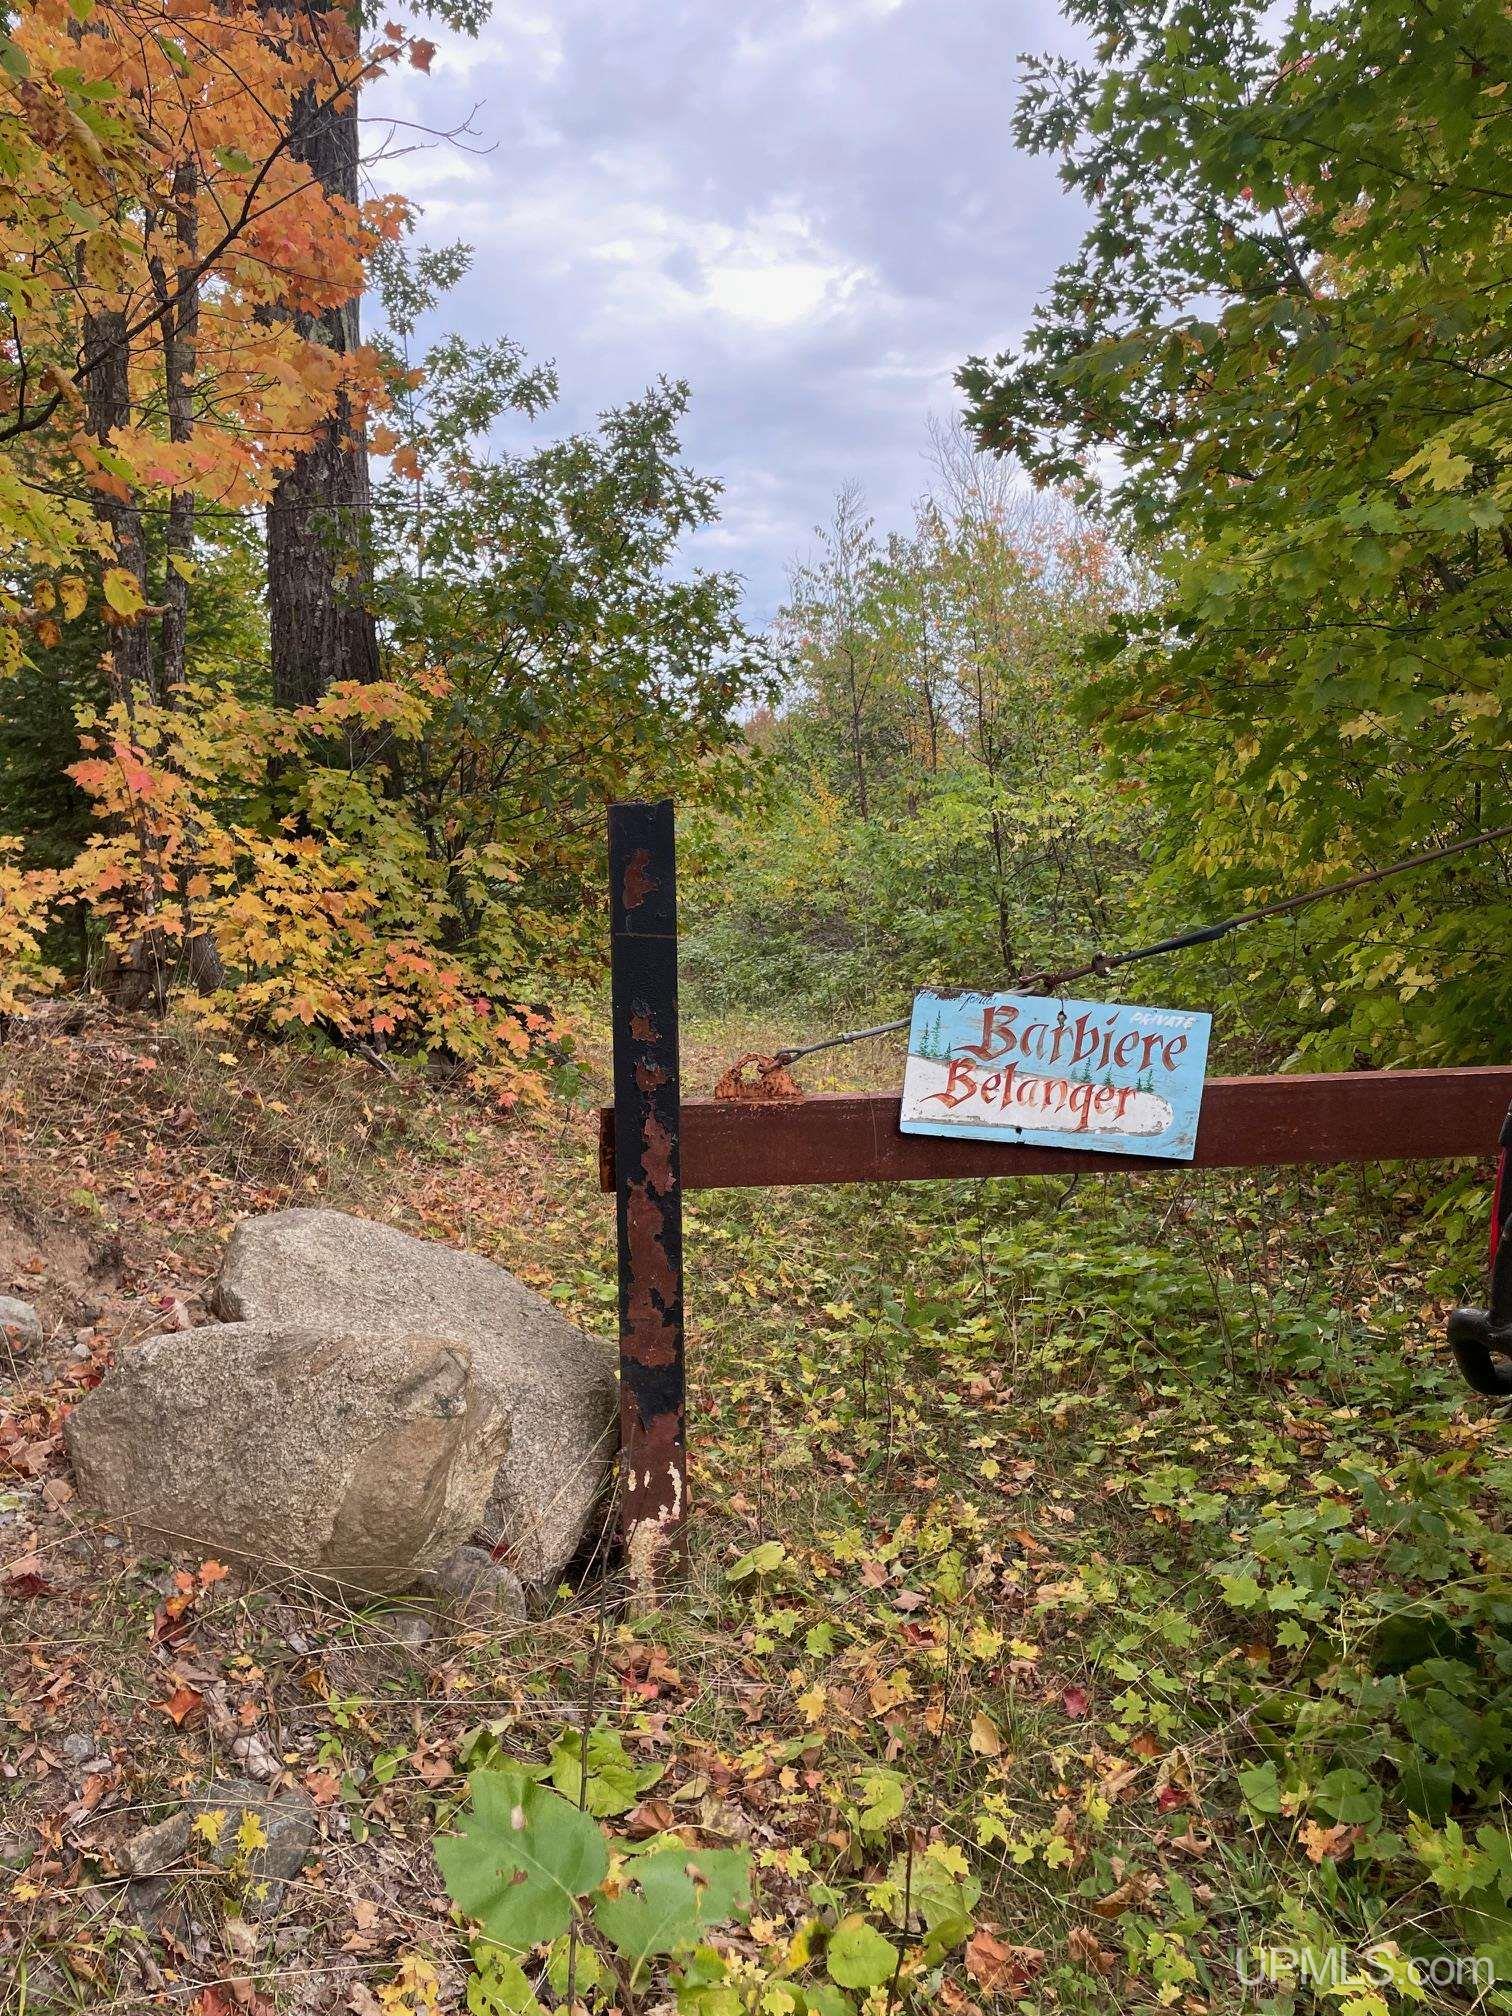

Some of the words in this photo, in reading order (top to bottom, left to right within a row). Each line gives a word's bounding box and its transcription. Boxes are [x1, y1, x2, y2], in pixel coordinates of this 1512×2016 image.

[952, 1005, 1188, 1072] Barbiere
[1131, 1012, 1196, 1029] PRIVATE
[920, 1058, 1137, 1133] Belanger
